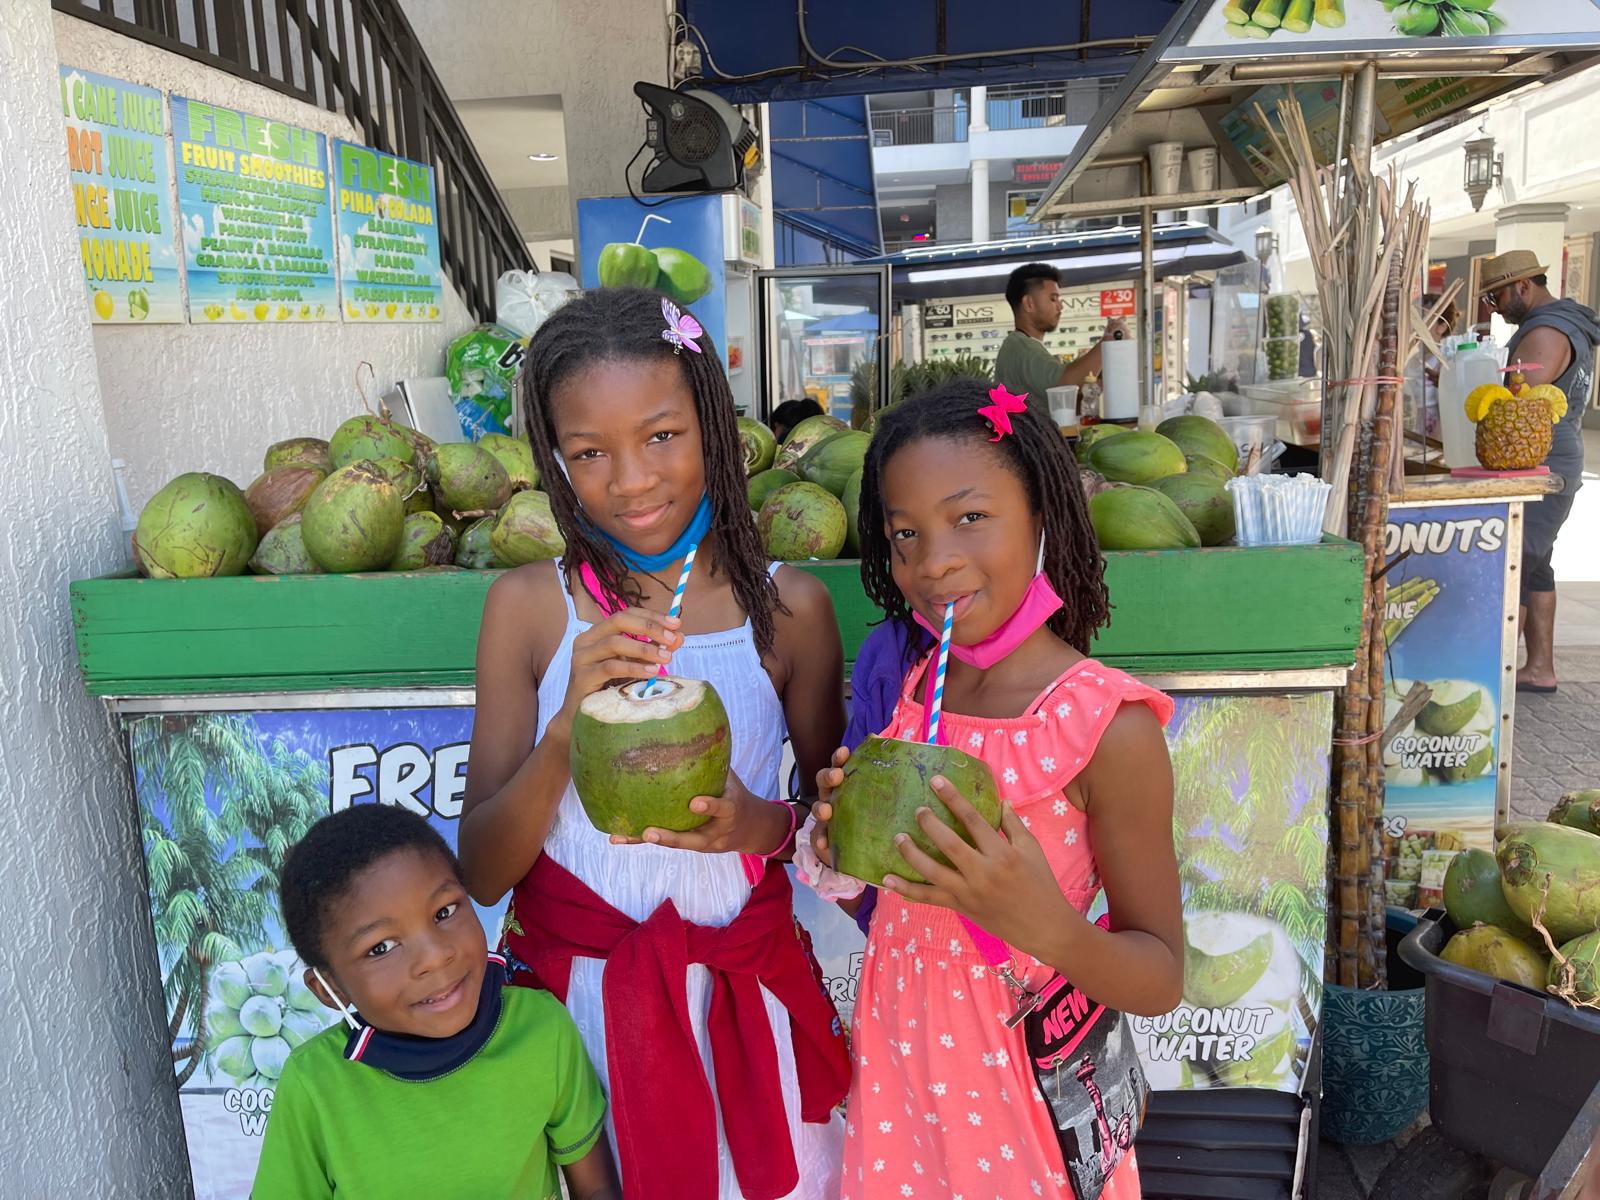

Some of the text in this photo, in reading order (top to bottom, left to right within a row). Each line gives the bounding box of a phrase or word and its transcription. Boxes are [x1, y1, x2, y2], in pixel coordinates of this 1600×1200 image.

[73, 79, 118, 127] CANE
[122, 90, 162, 136] JUICE
[187, 100, 319, 166] FRESH
[108, 134, 156, 183] JUICE
[181, 142, 325, 189] FRUIT SMOOTHIES
[340, 143, 430, 203] FRESH
[113, 188, 161, 234] JUICE
[388, 198, 434, 226] COLADA
[368, 219, 417, 239] BANANA
[354, 234, 429, 257] STRAWBERRY
[374, 253, 416, 271] MANGO
[956, 306, 994, 318] NYS
[1391, 735, 1481, 754] COCONUT
[1401, 752, 1471, 769] WATER
[1042, 988, 1090, 1045] NEW
[1132, 1006, 1274, 1034] COCONUT
[1149, 1034, 1257, 1062] WATER
